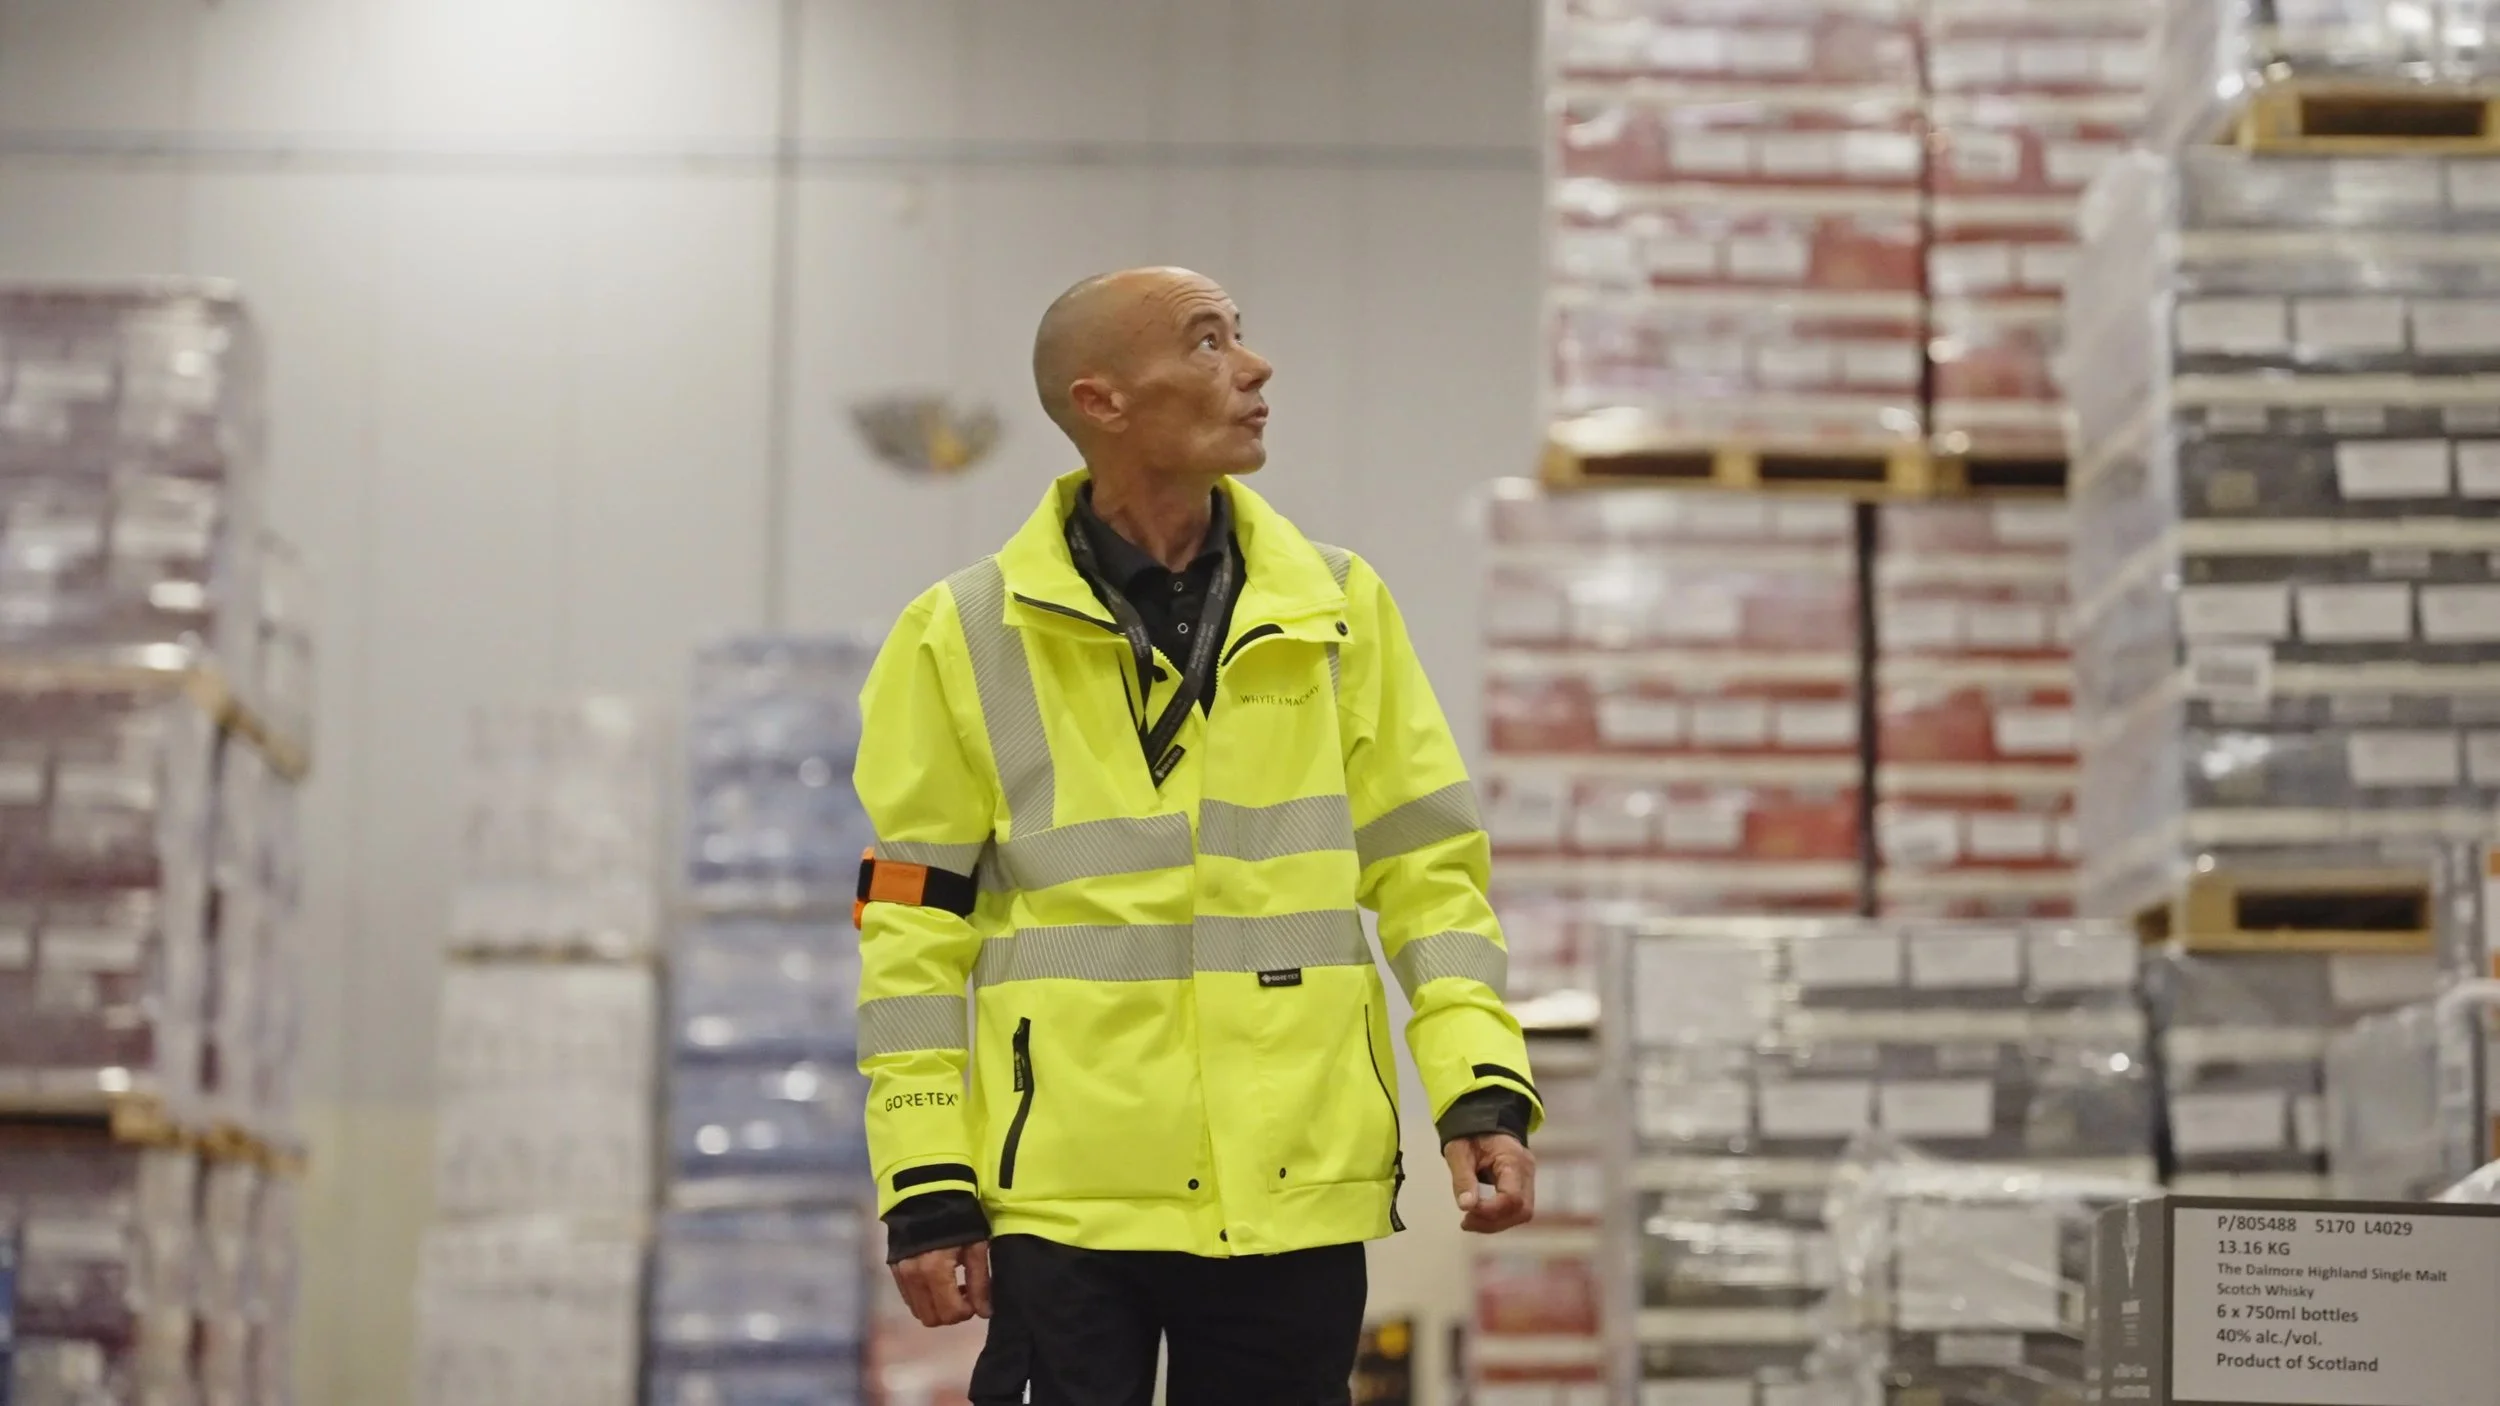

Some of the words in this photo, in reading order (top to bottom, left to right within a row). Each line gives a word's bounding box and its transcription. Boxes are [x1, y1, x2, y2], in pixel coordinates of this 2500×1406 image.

[1240, 694, 1275, 704] WHYTE
[2217, 1215, 2297, 1233] P/805488
[2364, 1219, 2414, 1237] L4029
[2218, 1239, 2263, 1256] 13.16
[2267, 1241, 2291, 1257] KG
[2217, 1262, 2243, 1276] The
[2245, 1263, 2304, 1278] Dalmore
[2307, 1265, 2368, 1282] Highland
[2371, 1267, 2412, 1284] Single
[2415, 1269, 2448, 1283] Malt
[2216, 1282, 2262, 1297] Scotch
[2265, 1284, 2316, 1301] Whisky
[2216, 1304, 2227, 1319] 6
[2231, 1307, 2241, 1319] x
[2245, 1305, 2297, 1321] 750ml
[2301, 1306, 2360, 1323] bottles
[2216, 1327, 2251, 1344] 40%
[2255, 1328, 2323, 1347] alc./vol.
[2216, 1352, 2282, 1370] Product
[2286, 1354, 2304, 1370] of
[2307, 1355, 2380, 1373] Scotland
